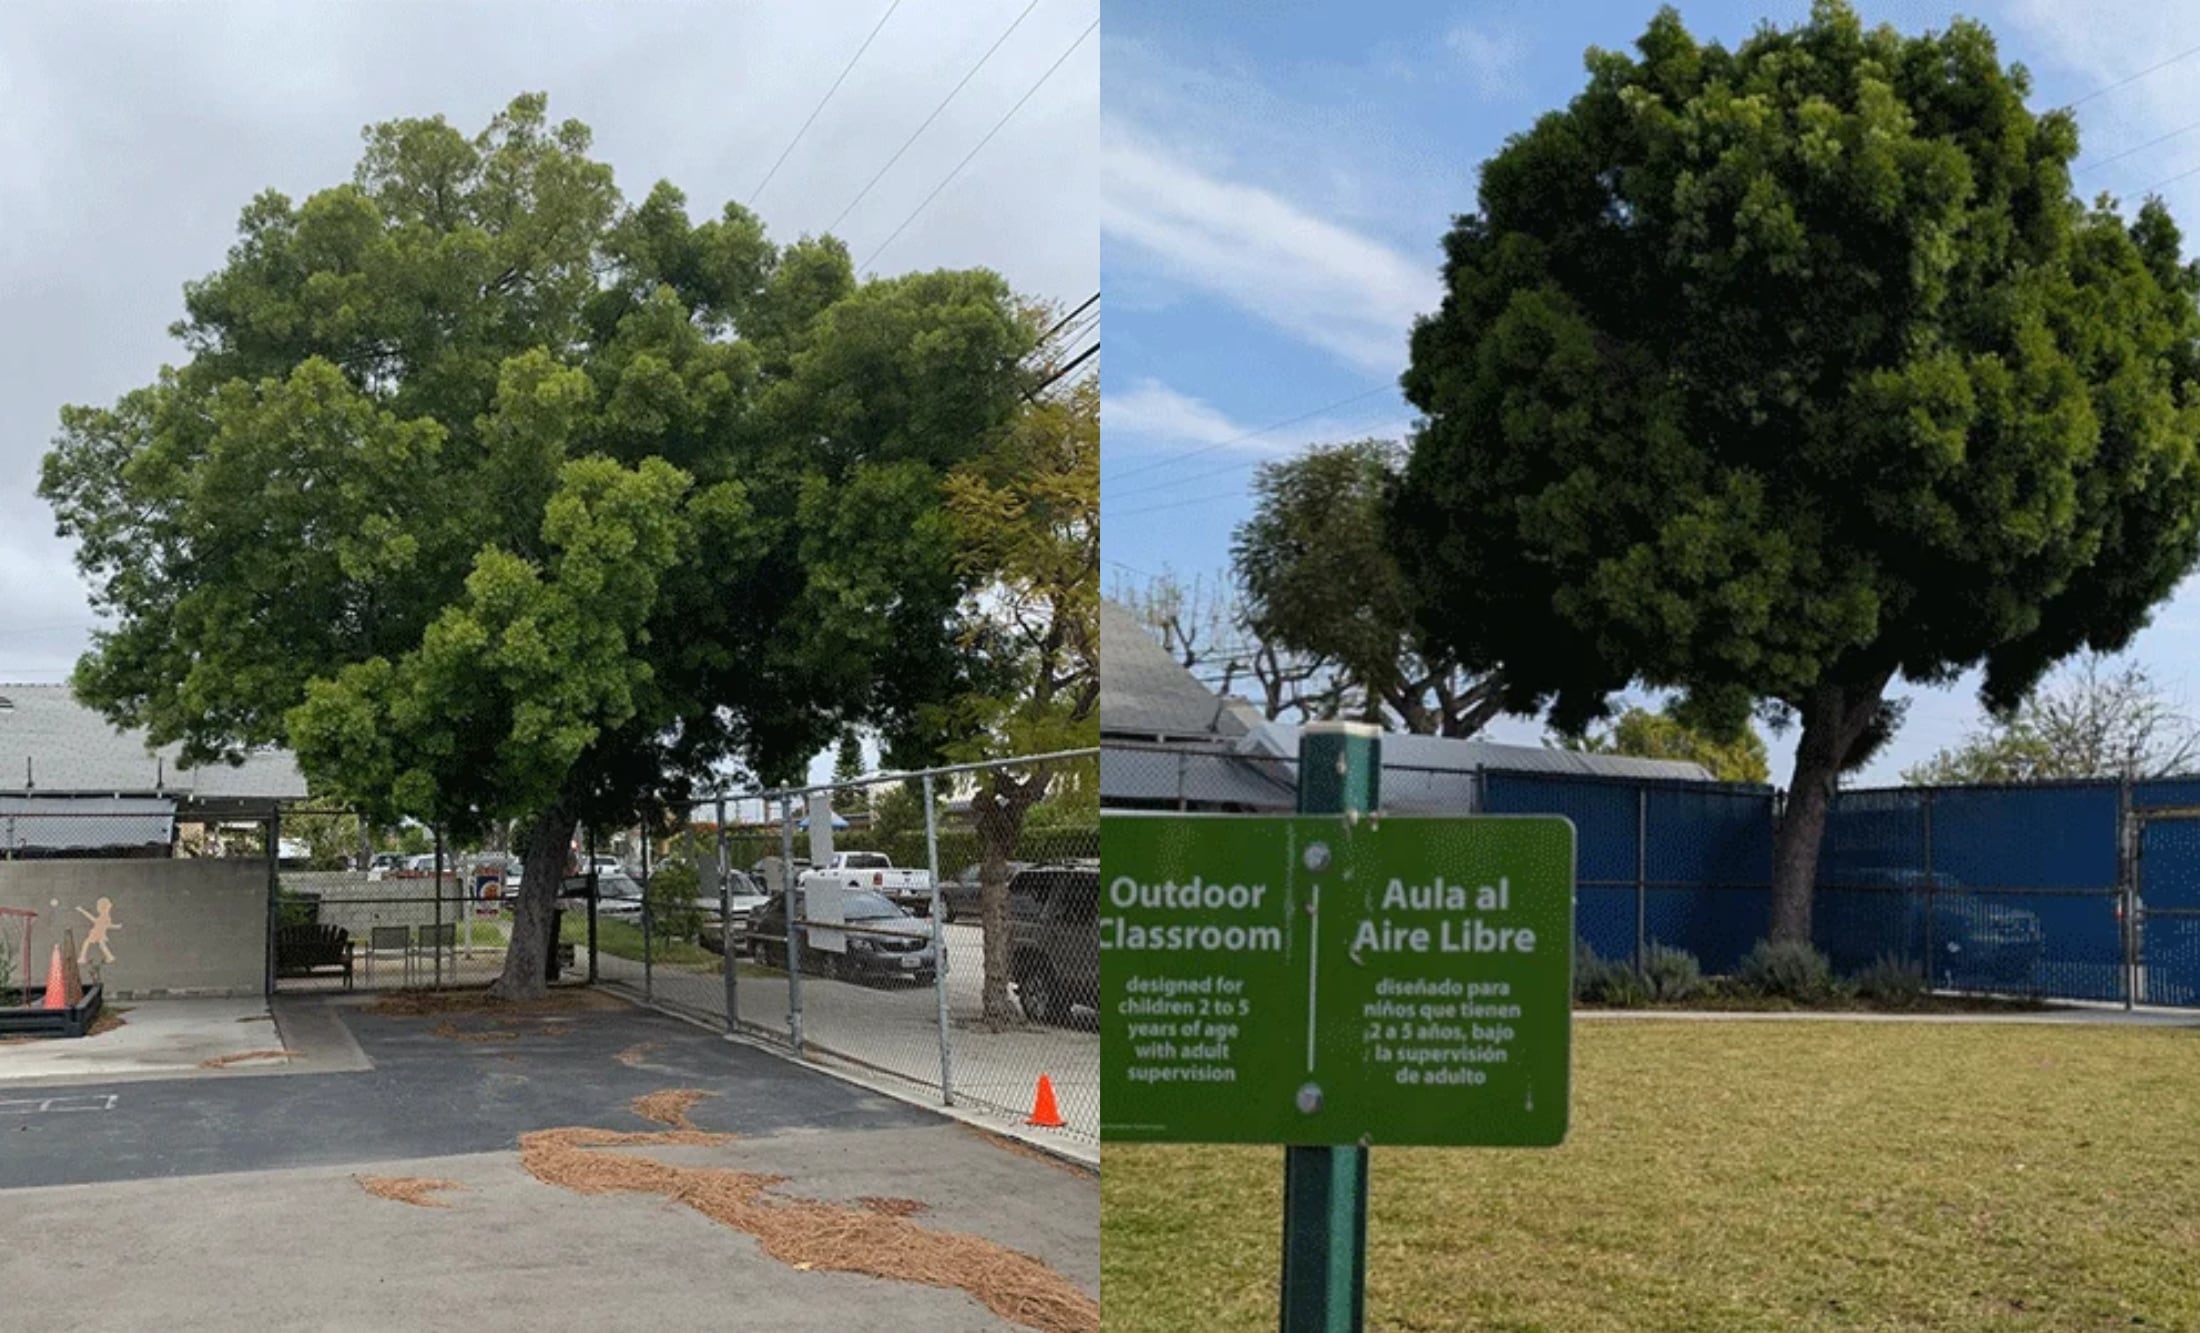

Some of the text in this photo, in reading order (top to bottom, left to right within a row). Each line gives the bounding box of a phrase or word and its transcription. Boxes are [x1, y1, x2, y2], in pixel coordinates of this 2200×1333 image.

[1109, 876, 1266, 909] Outdoor
[1381, 877, 1510, 911] Aula al
[1355, 919, 1537, 953] Aire Libre
[1125, 975, 1244, 998] designed for
[1375, 979, 1511, 1001] diseñado para
[1118, 997, 1250, 1016] children 2 to 5
[1364, 1000, 1521, 1021] niños que tienen
[1127, 1020, 1239, 1043] years of age
[1370, 1022, 1515, 1044] 2 a 5 años, bajo
[1135, 1041, 1230, 1060] with adult
[1375, 1044, 1508, 1065] la supervisión
[1127, 1063, 1236, 1084] supervision
[1396, 1066, 1487, 1085] de adulto
